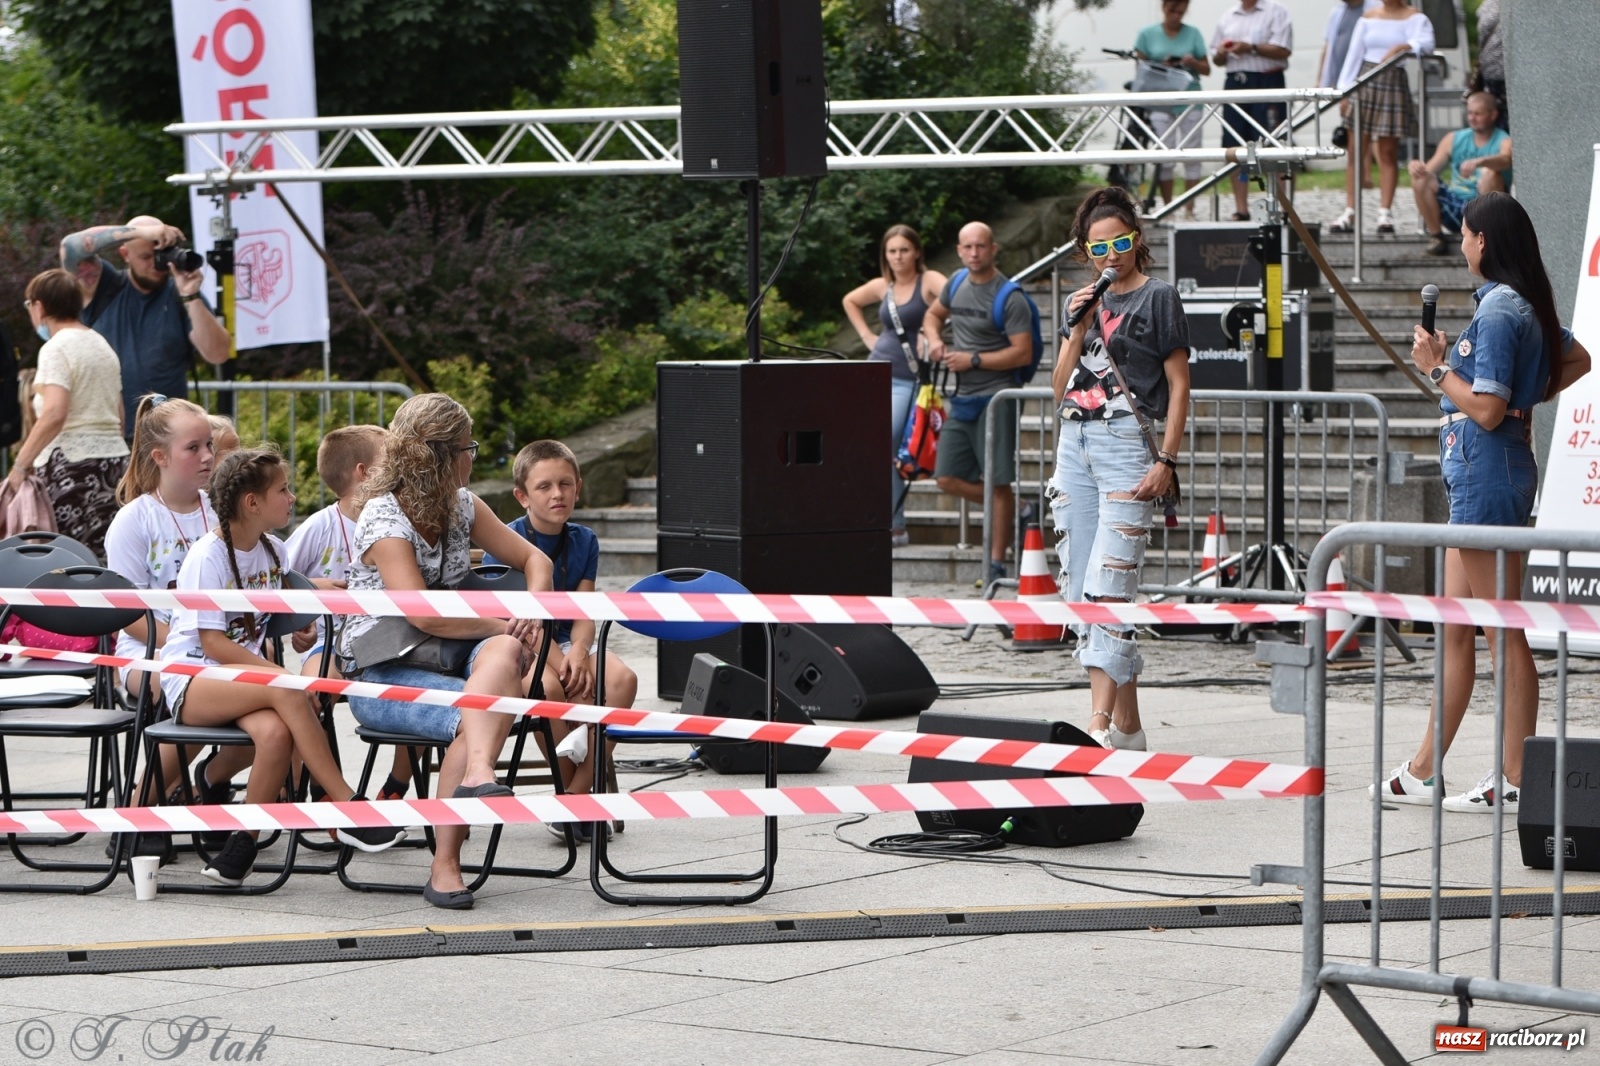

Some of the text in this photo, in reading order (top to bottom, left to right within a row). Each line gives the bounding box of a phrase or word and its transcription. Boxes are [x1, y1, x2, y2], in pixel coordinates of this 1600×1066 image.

[1573, 403, 1595, 424] ul.
[1567, 430, 1600, 449] 47-
[1587, 461, 1600, 480] 3
